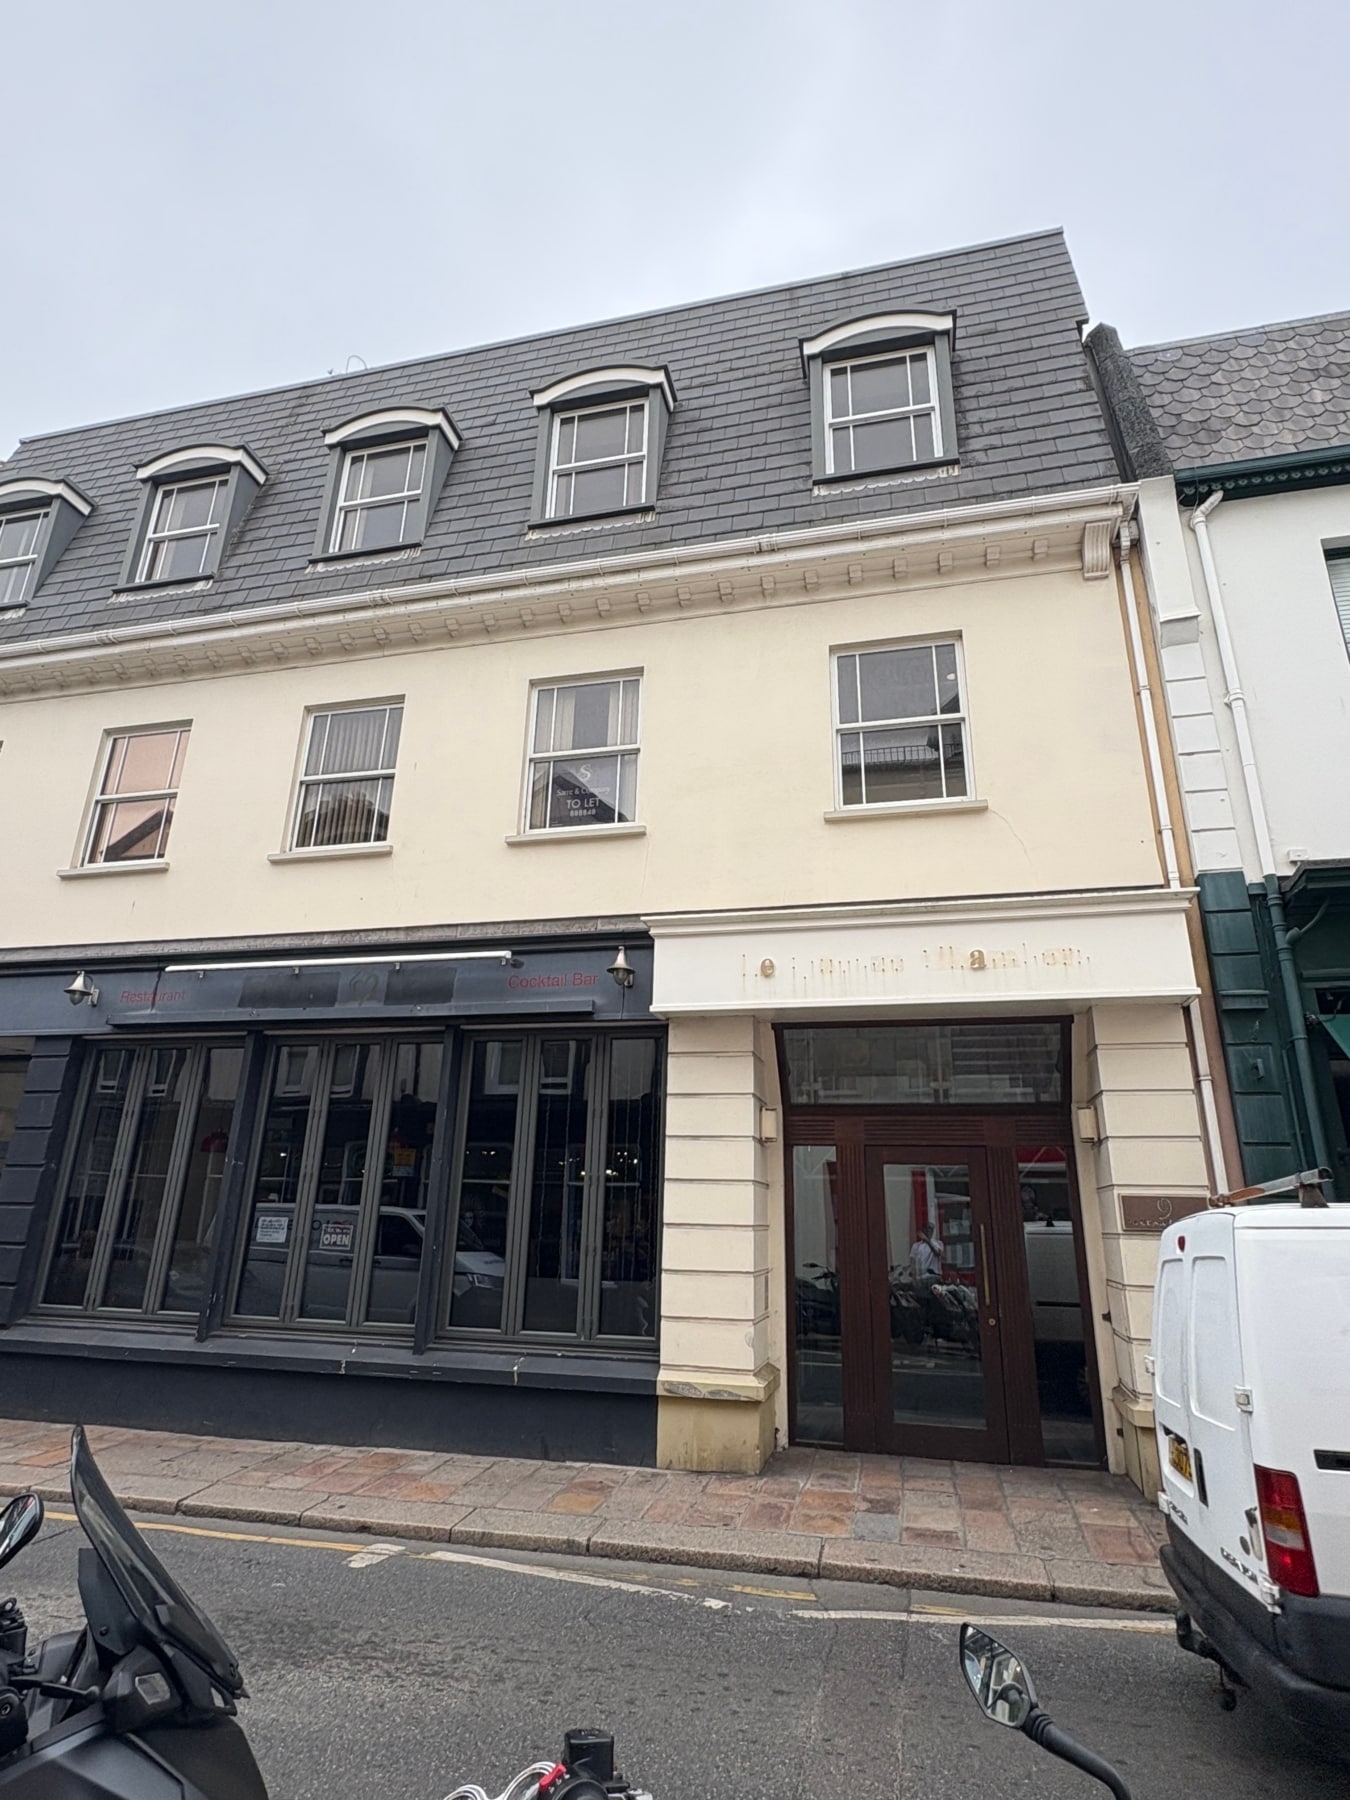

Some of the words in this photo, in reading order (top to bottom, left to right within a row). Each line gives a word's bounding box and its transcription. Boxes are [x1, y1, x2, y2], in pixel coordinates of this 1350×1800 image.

[566, 799, 581, 809] TO
[584, 798, 601, 808] LET
[508, 974, 567, 989] Cocktail
[572, 972, 599, 986] Bar
[120, 991, 186, 1002] Restaurant
[323, 1234, 350, 1245] OPEN
